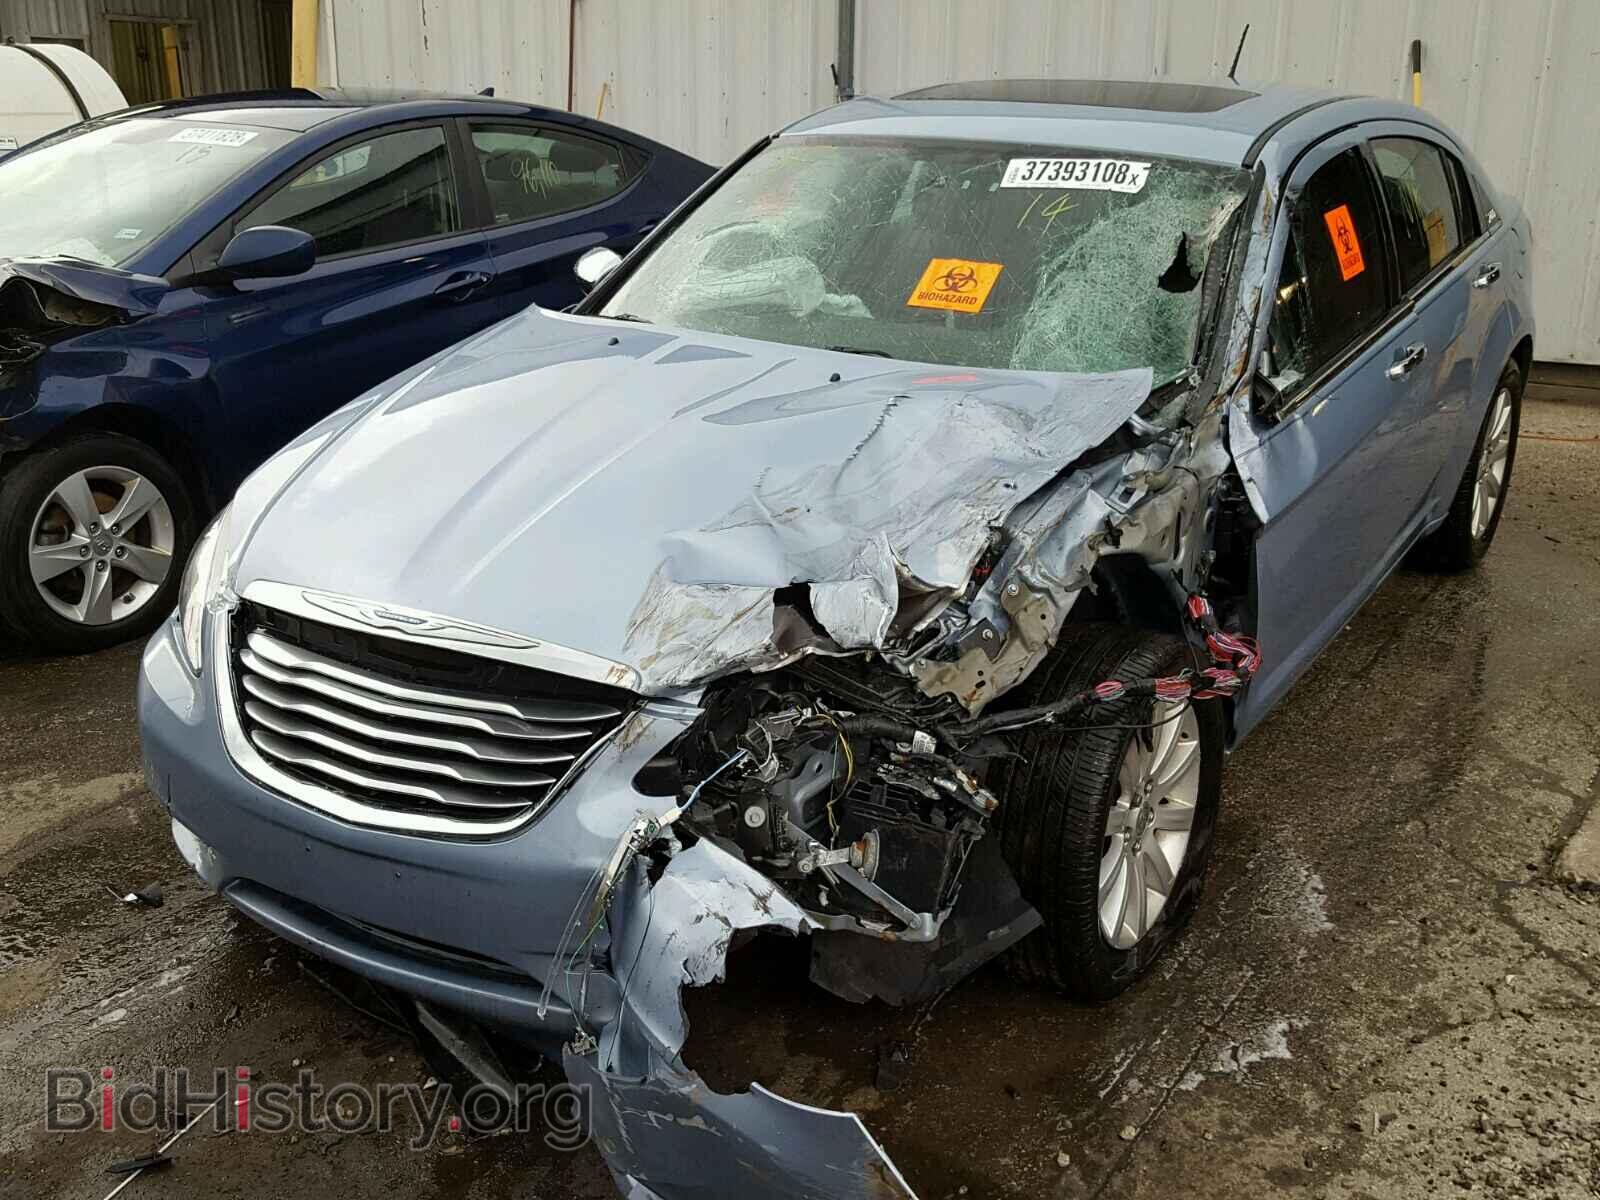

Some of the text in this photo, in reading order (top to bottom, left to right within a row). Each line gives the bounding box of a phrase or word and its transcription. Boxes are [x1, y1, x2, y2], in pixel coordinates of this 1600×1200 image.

[1021, 160, 1131, 185] 37393108
[1016, 193, 1080, 238] 14
[917, 291, 978, 305] BIOHAZARD
